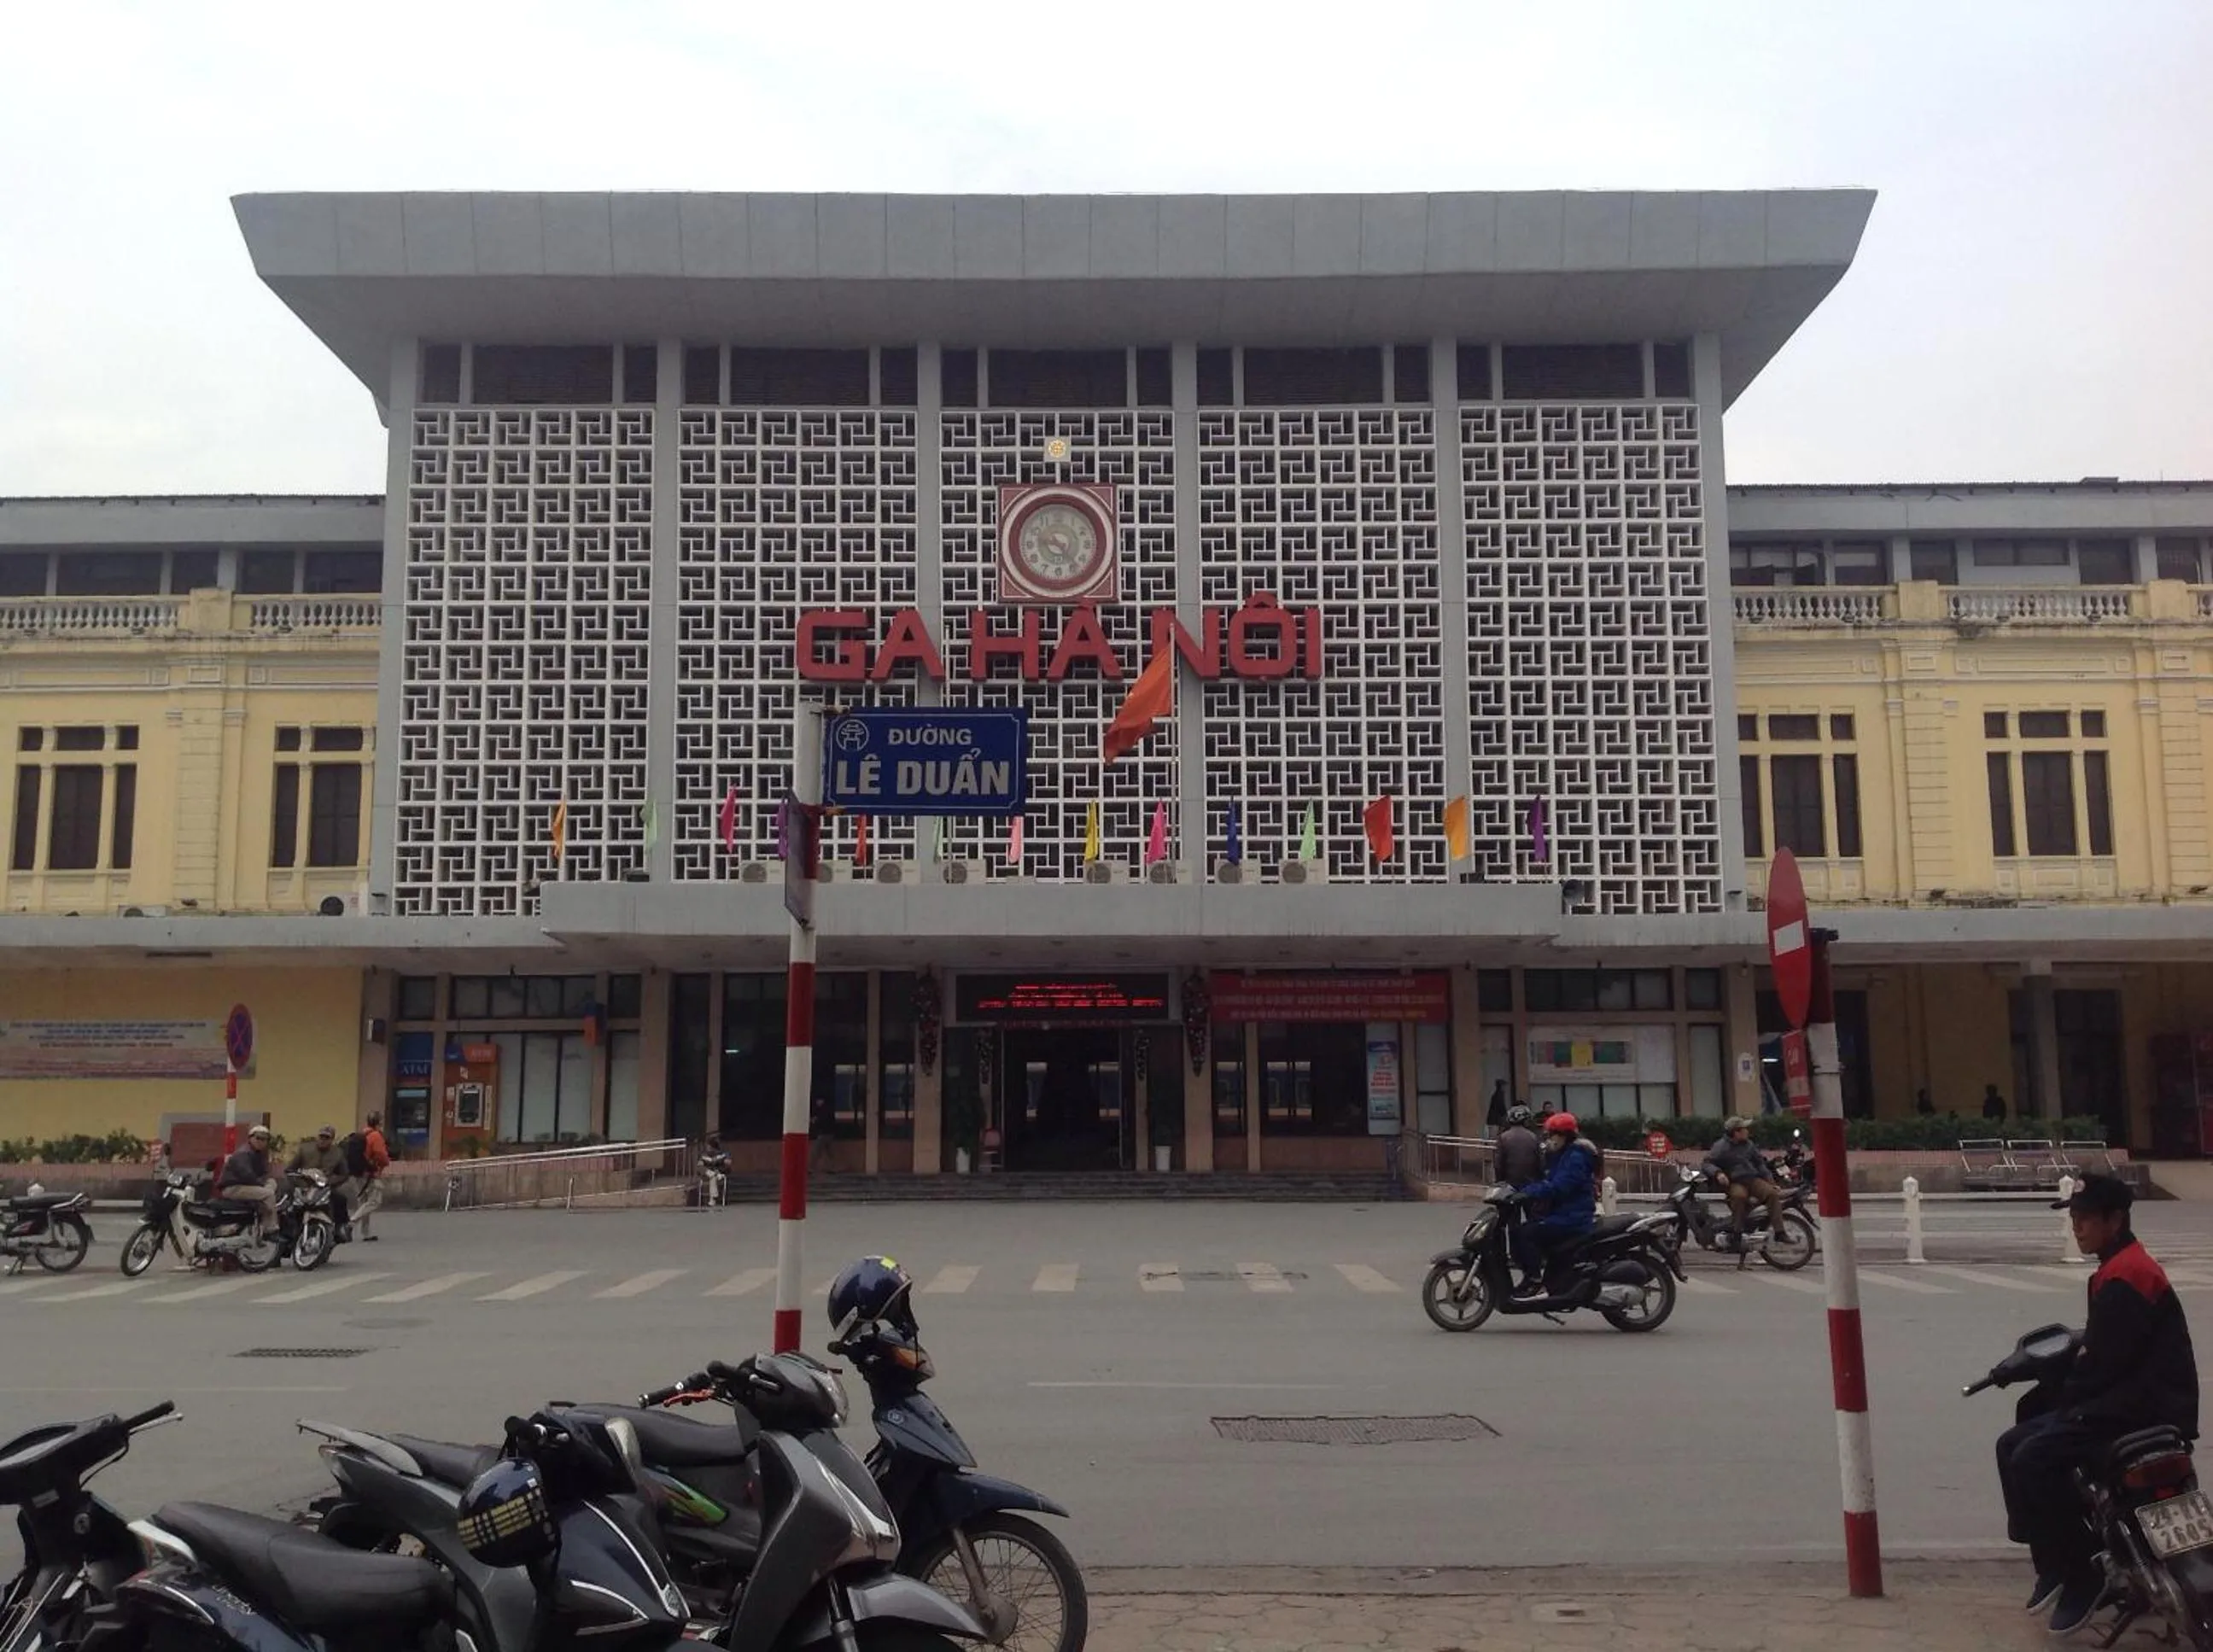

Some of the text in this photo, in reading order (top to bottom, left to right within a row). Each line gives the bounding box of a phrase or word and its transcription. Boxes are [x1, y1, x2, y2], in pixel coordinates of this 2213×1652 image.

[797, 607, 946, 681] GA
[971, 598, 1124, 681] HÀ
[888, 723, 972, 745] ĐƯỜNG
[836, 748, 1010, 795] LÊ DUẨN
